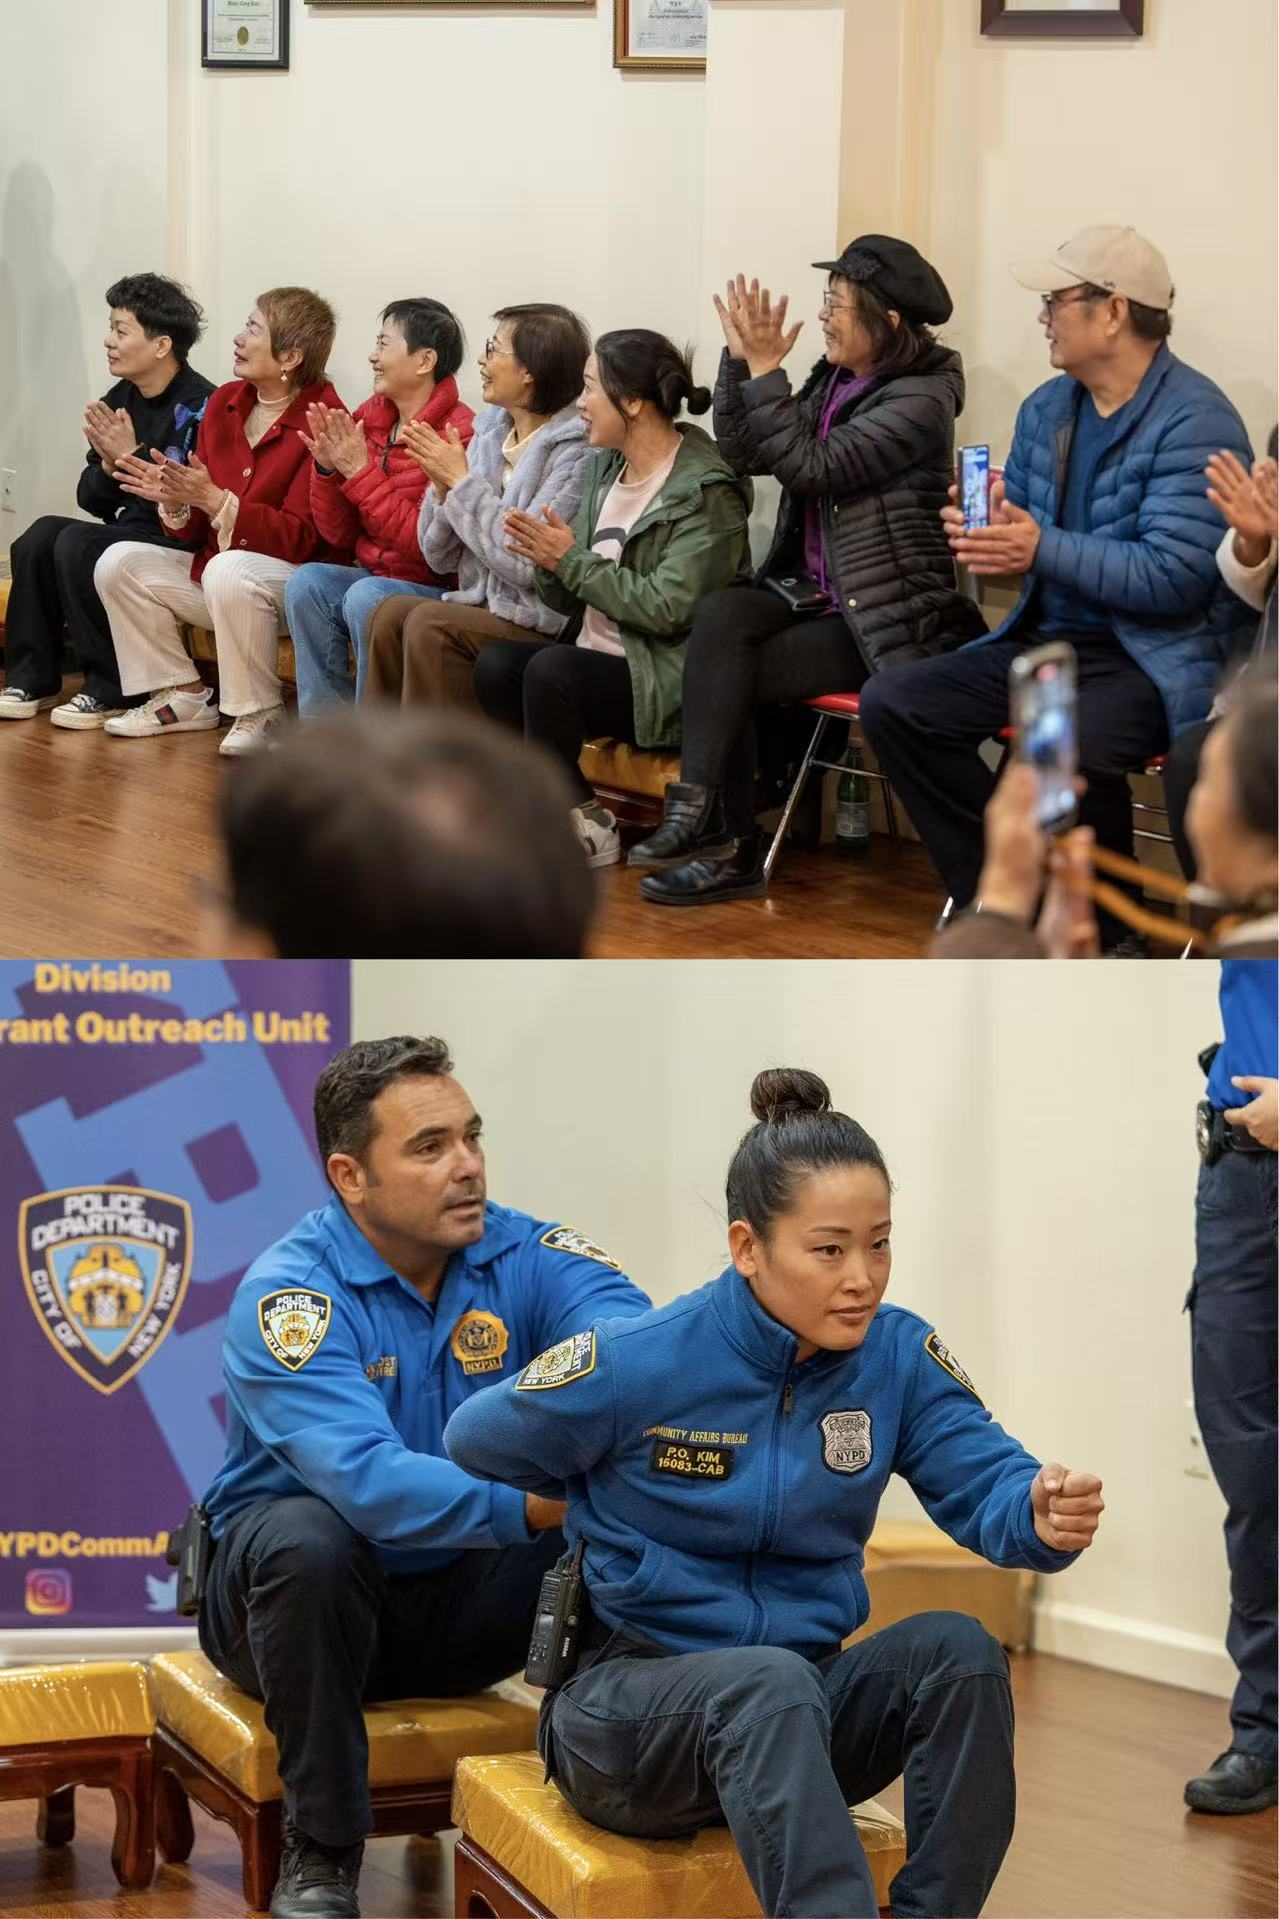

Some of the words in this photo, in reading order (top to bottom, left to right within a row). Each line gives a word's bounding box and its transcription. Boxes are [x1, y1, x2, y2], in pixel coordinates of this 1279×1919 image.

[35, 962, 171, 993] Division
[76, 1011, 247, 1043] Outreach
[253, 1011, 330, 1043] Unit
[64, 1193, 146, 1217] POLICE
[31, 1213, 180, 1251] DEPARTMENT
[31, 1269, 64, 1318] CITY
[53, 1321, 84, 1349] OF
[128, 1313, 163, 1358] NEW
[154, 1262, 182, 1311] YORK
[264, 1302, 326, 1321] DEPARTMENT
[276, 1294, 312, 1306] POLICE
[265, 1330, 279, 1349] CITY
[276, 1347, 289, 1359] OF
[298, 1341, 315, 1360] NEW
[312, 1319, 326, 1342] YORK
[541, 1373, 565, 1385] YORK
[642, 1426, 688, 1440] COMMUNITY
[689, 1430, 721, 1443] AFFAIRS
[722, 1432, 749, 1444] BUREAU
[666, 1446, 690, 1461] P.O.
[696, 1451, 720, 1464] KIM
[836, 1450, 866, 1462] NYPD
